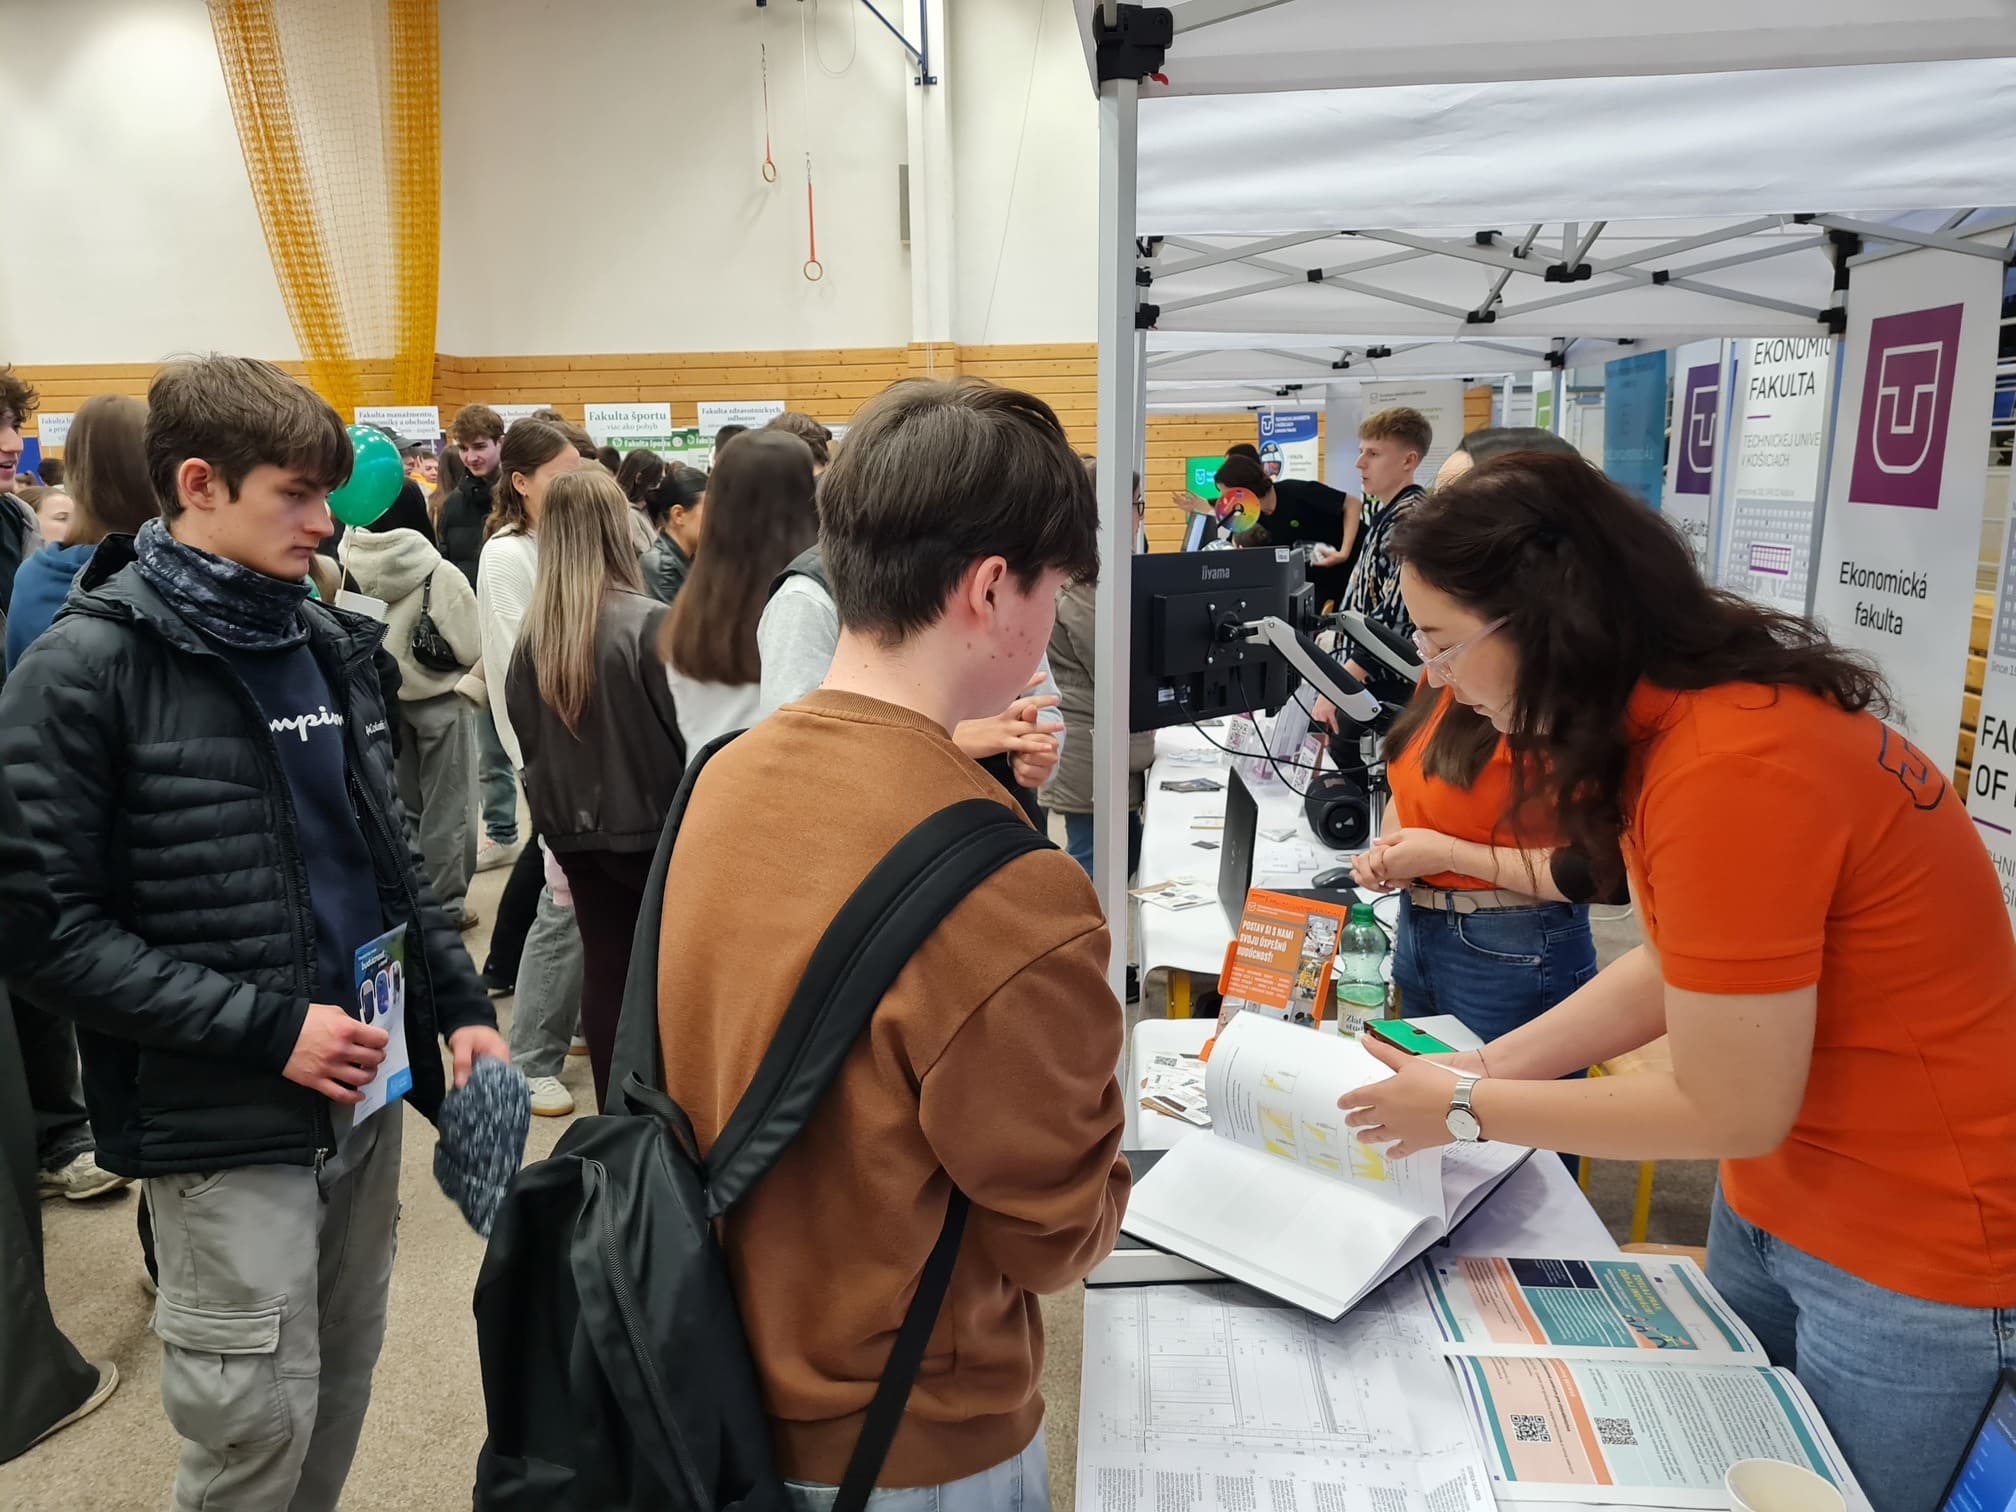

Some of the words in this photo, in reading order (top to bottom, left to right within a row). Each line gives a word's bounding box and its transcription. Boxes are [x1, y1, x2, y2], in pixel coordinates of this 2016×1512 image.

[1750, 371, 1815, 400] FAKULTA
[589, 411, 629, 421] Fakulta
[631, 411, 667, 423] športu
[1840, 561, 1927, 599] Ekonomická
[1855, 601, 1903, 635] fakulta
[1976, 763, 2008, 801] OF
[1988, 849, 2016, 877] HNI
[1242, 920, 1265, 934] POSTAV
[1276, 927, 1294, 940] NAMI
